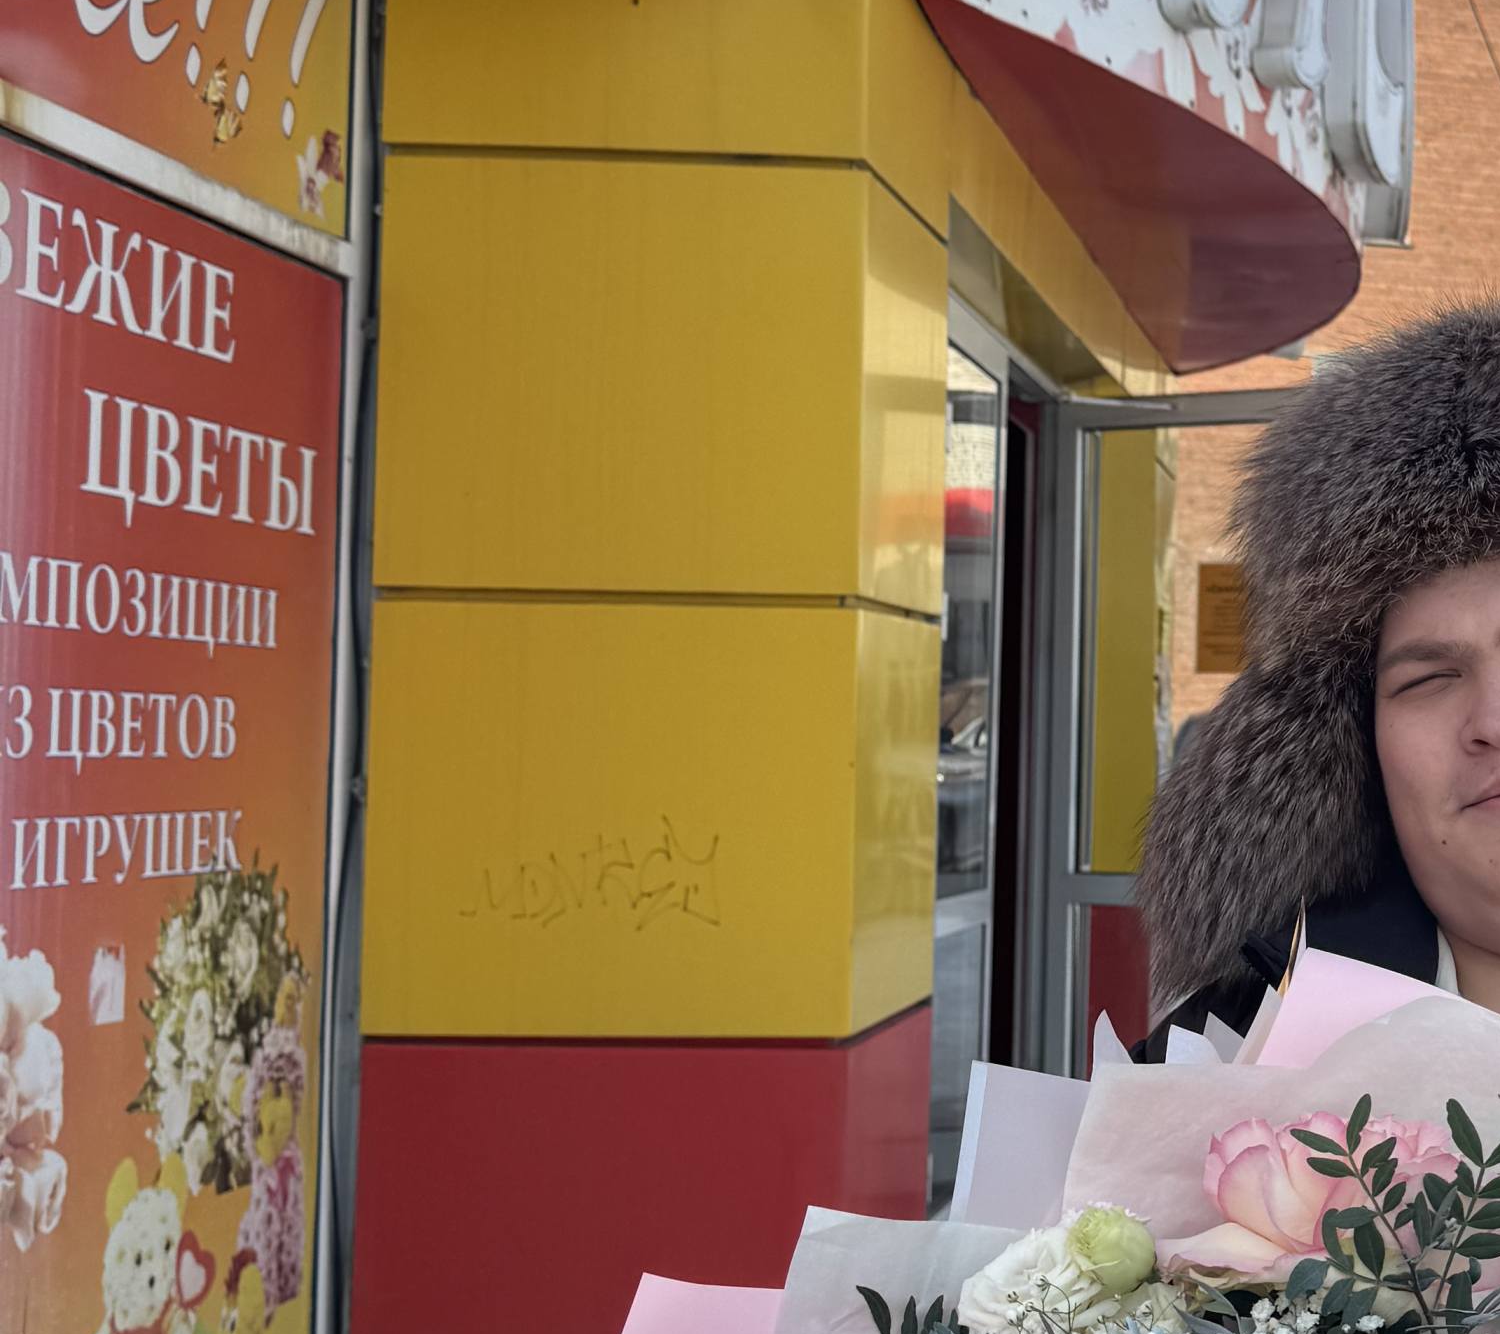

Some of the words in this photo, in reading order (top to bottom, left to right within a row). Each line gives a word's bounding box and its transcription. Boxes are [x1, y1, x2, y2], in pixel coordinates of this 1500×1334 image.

[0, 180, 236, 363] ЕЖИЕ
[80, 387, 318, 535] ЦВЕТЫ
[0, 684, 34, 759] З
[46, 687, 237, 775] ЦВЕТОВ
[9, 809, 243, 890] ИГРУШЕК
